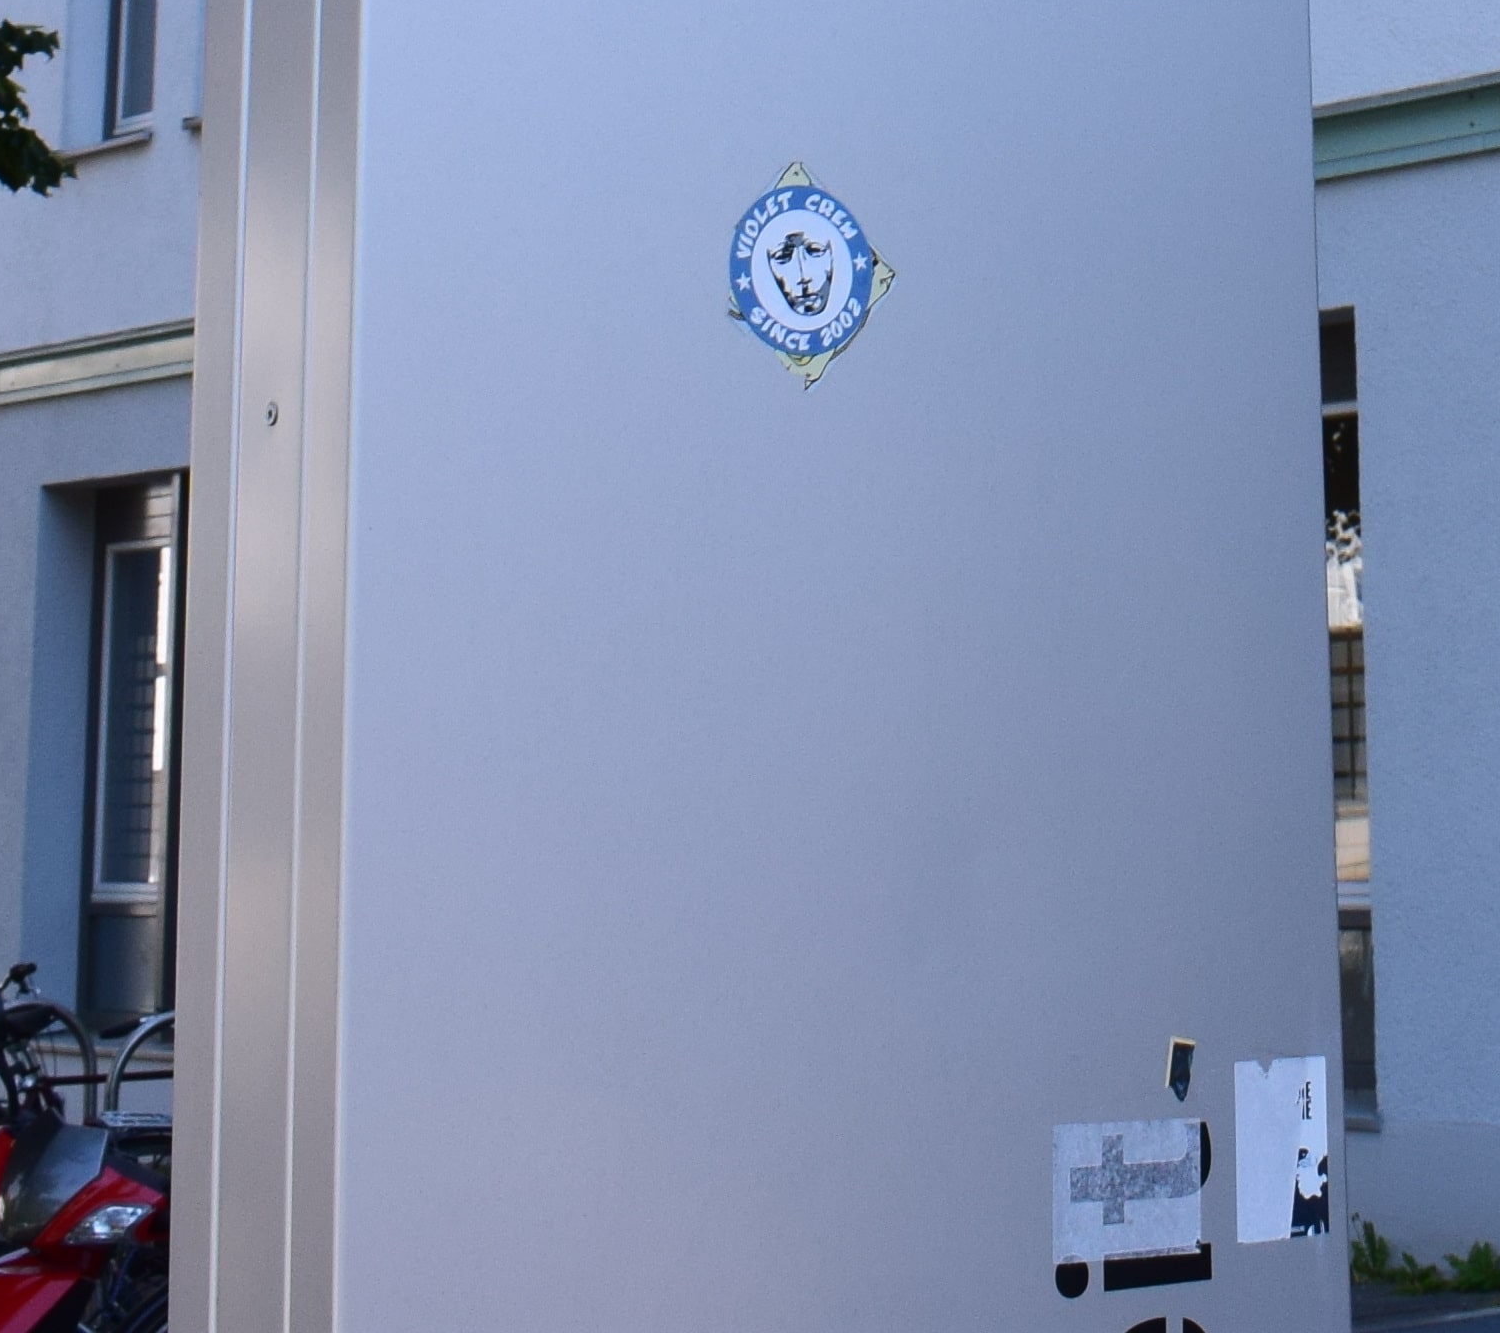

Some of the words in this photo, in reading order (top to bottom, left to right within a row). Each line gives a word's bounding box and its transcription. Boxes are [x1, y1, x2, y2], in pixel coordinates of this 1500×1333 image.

[736, 190, 793, 259] VIOLET
[805, 193, 859, 240] CREW
[750, 306, 812, 351] SINCE
[820, 296, 862, 347] 2002
